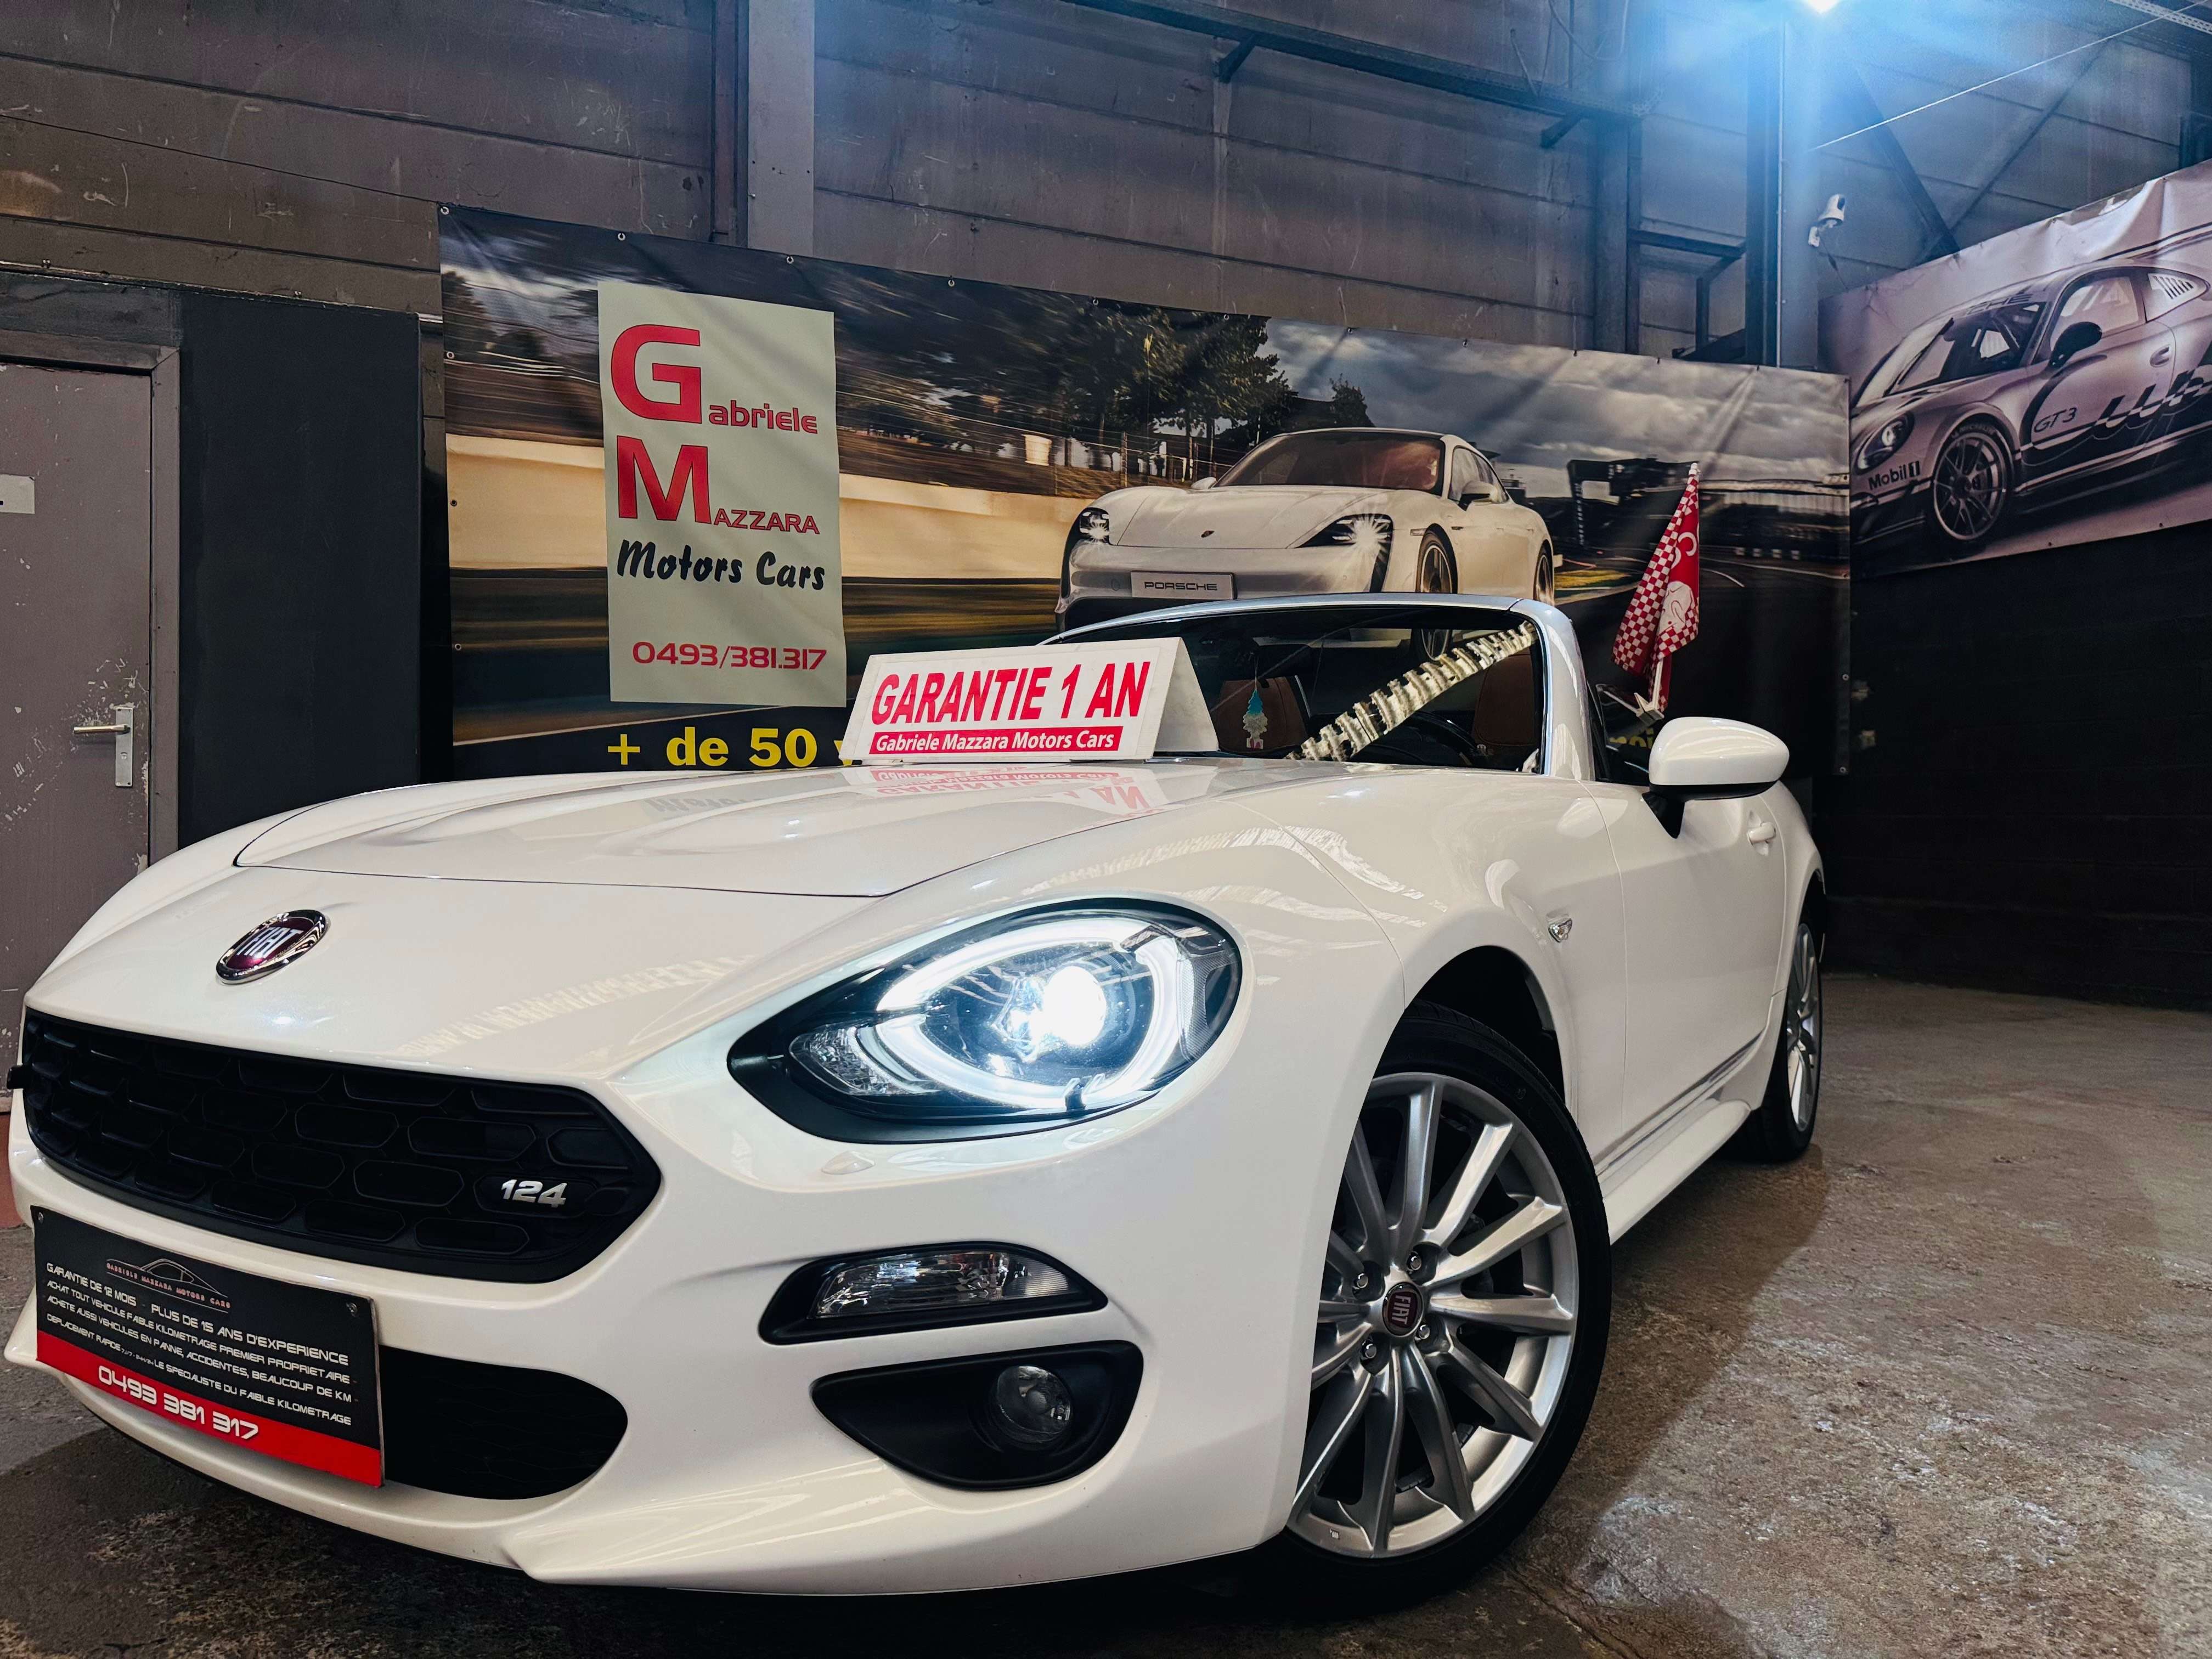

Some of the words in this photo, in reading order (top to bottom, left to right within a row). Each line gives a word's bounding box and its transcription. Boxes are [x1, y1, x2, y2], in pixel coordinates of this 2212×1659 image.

[610, 324, 818, 435] Gabriele
[2034, 408, 2077, 432] GT3
[617, 436, 820, 535] MAZZARA
[1869, 465, 1906, 490] Mobil
[617, 539, 743, 583] Motors
[755, 551, 825, 590] Cars
[1144, 582, 1217, 591] PORSCHE
[632, 641, 827, 671] 0493/381.317
[871, 667, 1053, 725] GARANTIE
[1061, 664, 1081, 719] 1
[1085, 661, 1150, 718] AN
[666, 726, 729, 766] de
[748, 728, 817, 767] 50
[876, 732, 939, 752] Gabriele
[943, 732, 1009, 750] Mazzara
[1012, 731, 1074, 749] Motors
[1076, 730, 1114, 748] Cars
[236, 927, 304, 958] FIAT
[501, 1180, 567, 1207] 124
[47, 1262, 88, 1287] GARANTIE
[90, 1281, 103, 1293] DE
[104, 1286, 113, 1296] 12
[115, 1291, 137, 1306] MOIS
[106, 1263, 138, 1279] GABRIELE
[142, 1276, 172, 1291] MAZZARA
[176, 1287, 205, 1301] MOTORS
[210, 1297, 231, 1308] CARS
[47, 1280, 69, 1295] ACHAT
[71, 1289, 90, 1302] TOUT
[92, 1297, 126, 1318] VEHICULE
[127, 1311, 154, 1329] FAIBLE
[155, 1323, 217, 1351] KILOMETRAGE
[219, 1345, 264, 1364] PREMIER
[268, 1357, 350, 1384] PROPRIETAIRE
[1392, 1295, 1411, 1325] FIAT
[47, 1295, 75, 1312] ACHETE
[77, 1306, 97, 1322] AUSSI
[99, 1313, 139, 1339] VEHICULES
[140, 1333, 152, 1345] EN
[187, 1351, 250, 1379] ACCIDENTES,
[252, 1370, 313, 1392] BEAUCOUP
[317, 1386, 332, 1398] DE
[335, 1390, 352, 1403] KM
[151, 1304, 179, 1322] PLUS
[183, 1314, 198, 1328] DE
[201, 1321, 213, 1333] 15
[217, 1327, 242, 1341] ANS
[247, 1333, 349, 1365] D'EXPERIENCE
[47, 1314, 95, 1340] DEPLACEMENT
[96, 1334, 121, 1352] RAPIDE
[154, 1359, 165, 1370] LE
[166, 1364, 221, 1390] SPECIALISTE
[224, 1384, 237, 1395] DU
[240, 1389, 275, 1406] FAIBLE
[277, 1399, 352, 1426] KILOMETRAGE
[98, 1365, 157, 1405] 0493
[163, 1392, 205, 1425] 381
[213, 1411, 259, 1440] 317
